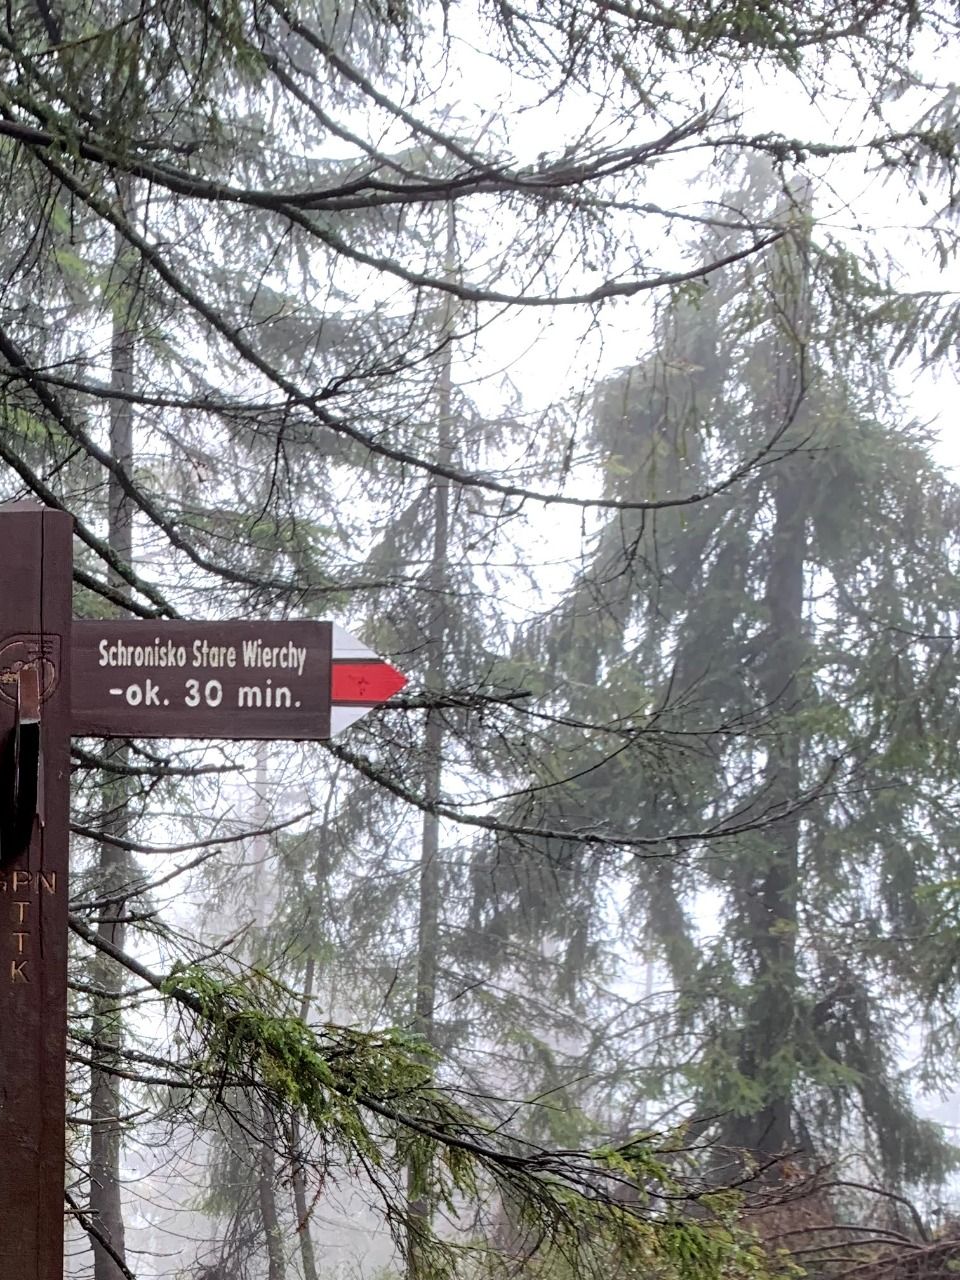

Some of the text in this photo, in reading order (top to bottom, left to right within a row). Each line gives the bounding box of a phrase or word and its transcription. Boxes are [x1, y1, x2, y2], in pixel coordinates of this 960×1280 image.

[98, 637, 307, 676] Schronisko Stare Wierchy
[108, 678, 302, 708] -ok. 30 min.
